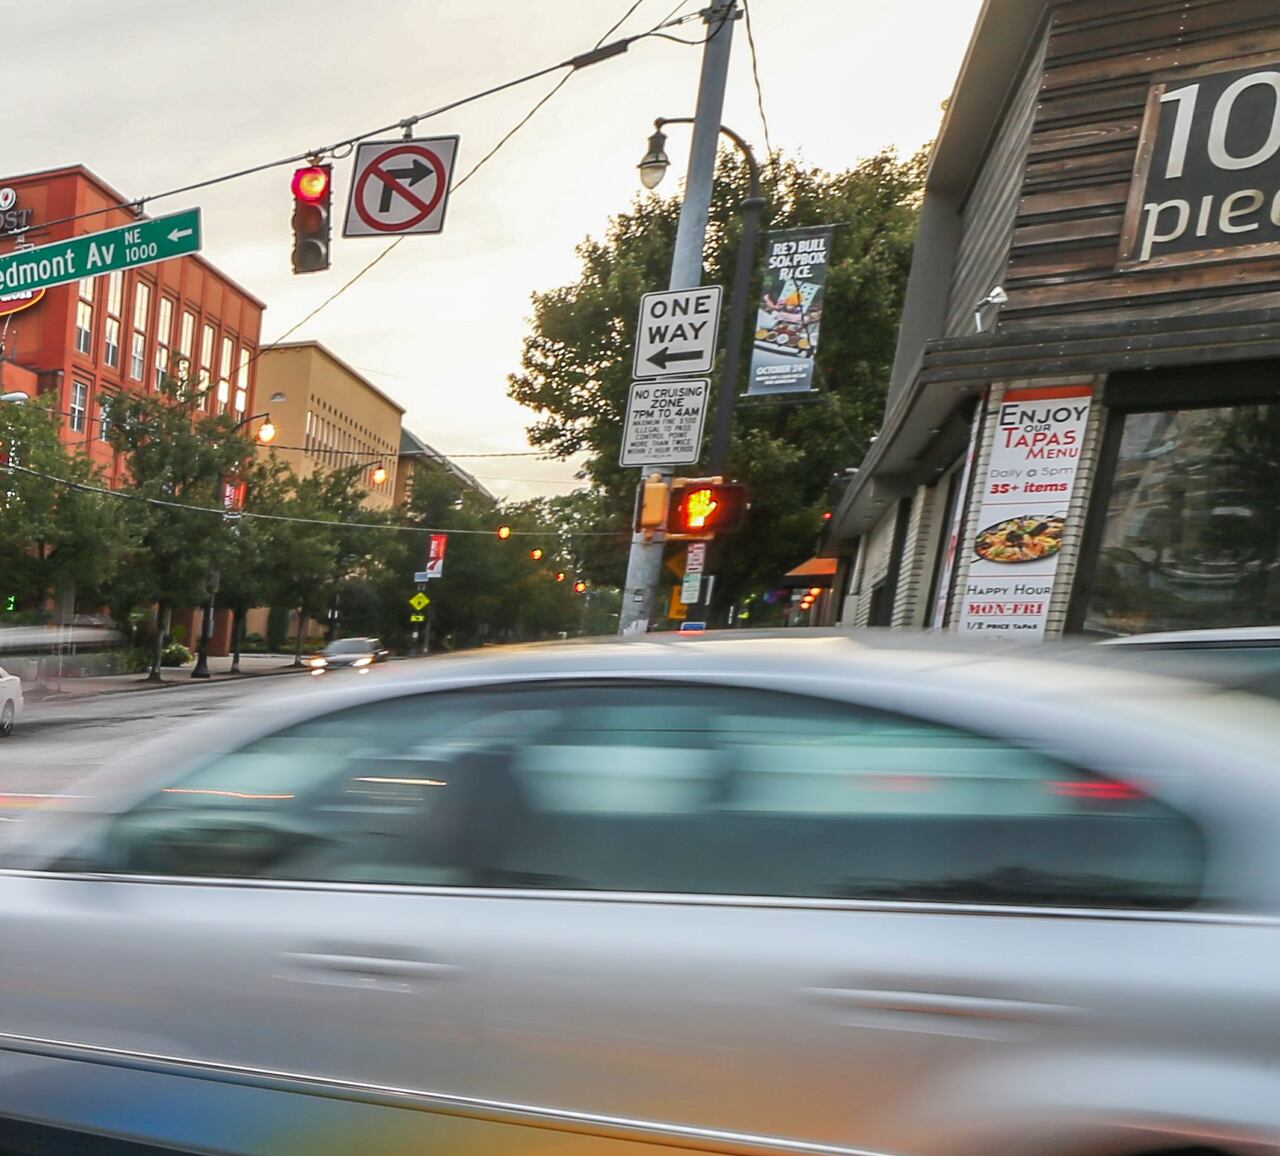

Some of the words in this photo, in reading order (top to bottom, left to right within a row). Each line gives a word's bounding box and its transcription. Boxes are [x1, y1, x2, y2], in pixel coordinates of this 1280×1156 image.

[1140, 189, 1280, 261] pie
[124, 229, 142, 246] NE
[125, 242, 157, 262] 1000
[798, 239, 826, 253] BULL
[86, 242, 115, 270] Av
[650, 295, 711, 319] ONE
[648, 321, 708, 344] WAY
[634, 390, 650, 400] NO
[653, 386, 702, 399] CRUISING
[650, 398, 684, 409] ZONE
[632, 410, 654, 419] 7PM
[658, 409, 671, 418] TO
[674, 407, 699, 417] 4AM
[999, 404, 1089, 426] ENJOY
[1023, 424, 1052, 433] OUR
[1002, 427, 1077, 449] TAPAS
[1025, 447, 1078, 460] MENU
[989, 468, 1023, 479] Daily
[1041, 466, 1073, 477] 5pm
[990, 483, 1020, 494] 35+
[1023, 482, 1068, 493] items
[966, 585, 1009, 595] HAPPY
[1013, 583, 1052, 595] HOUR
[968, 603, 1044, 614] MON-FRI
[966, 621, 984, 630] 1/2
